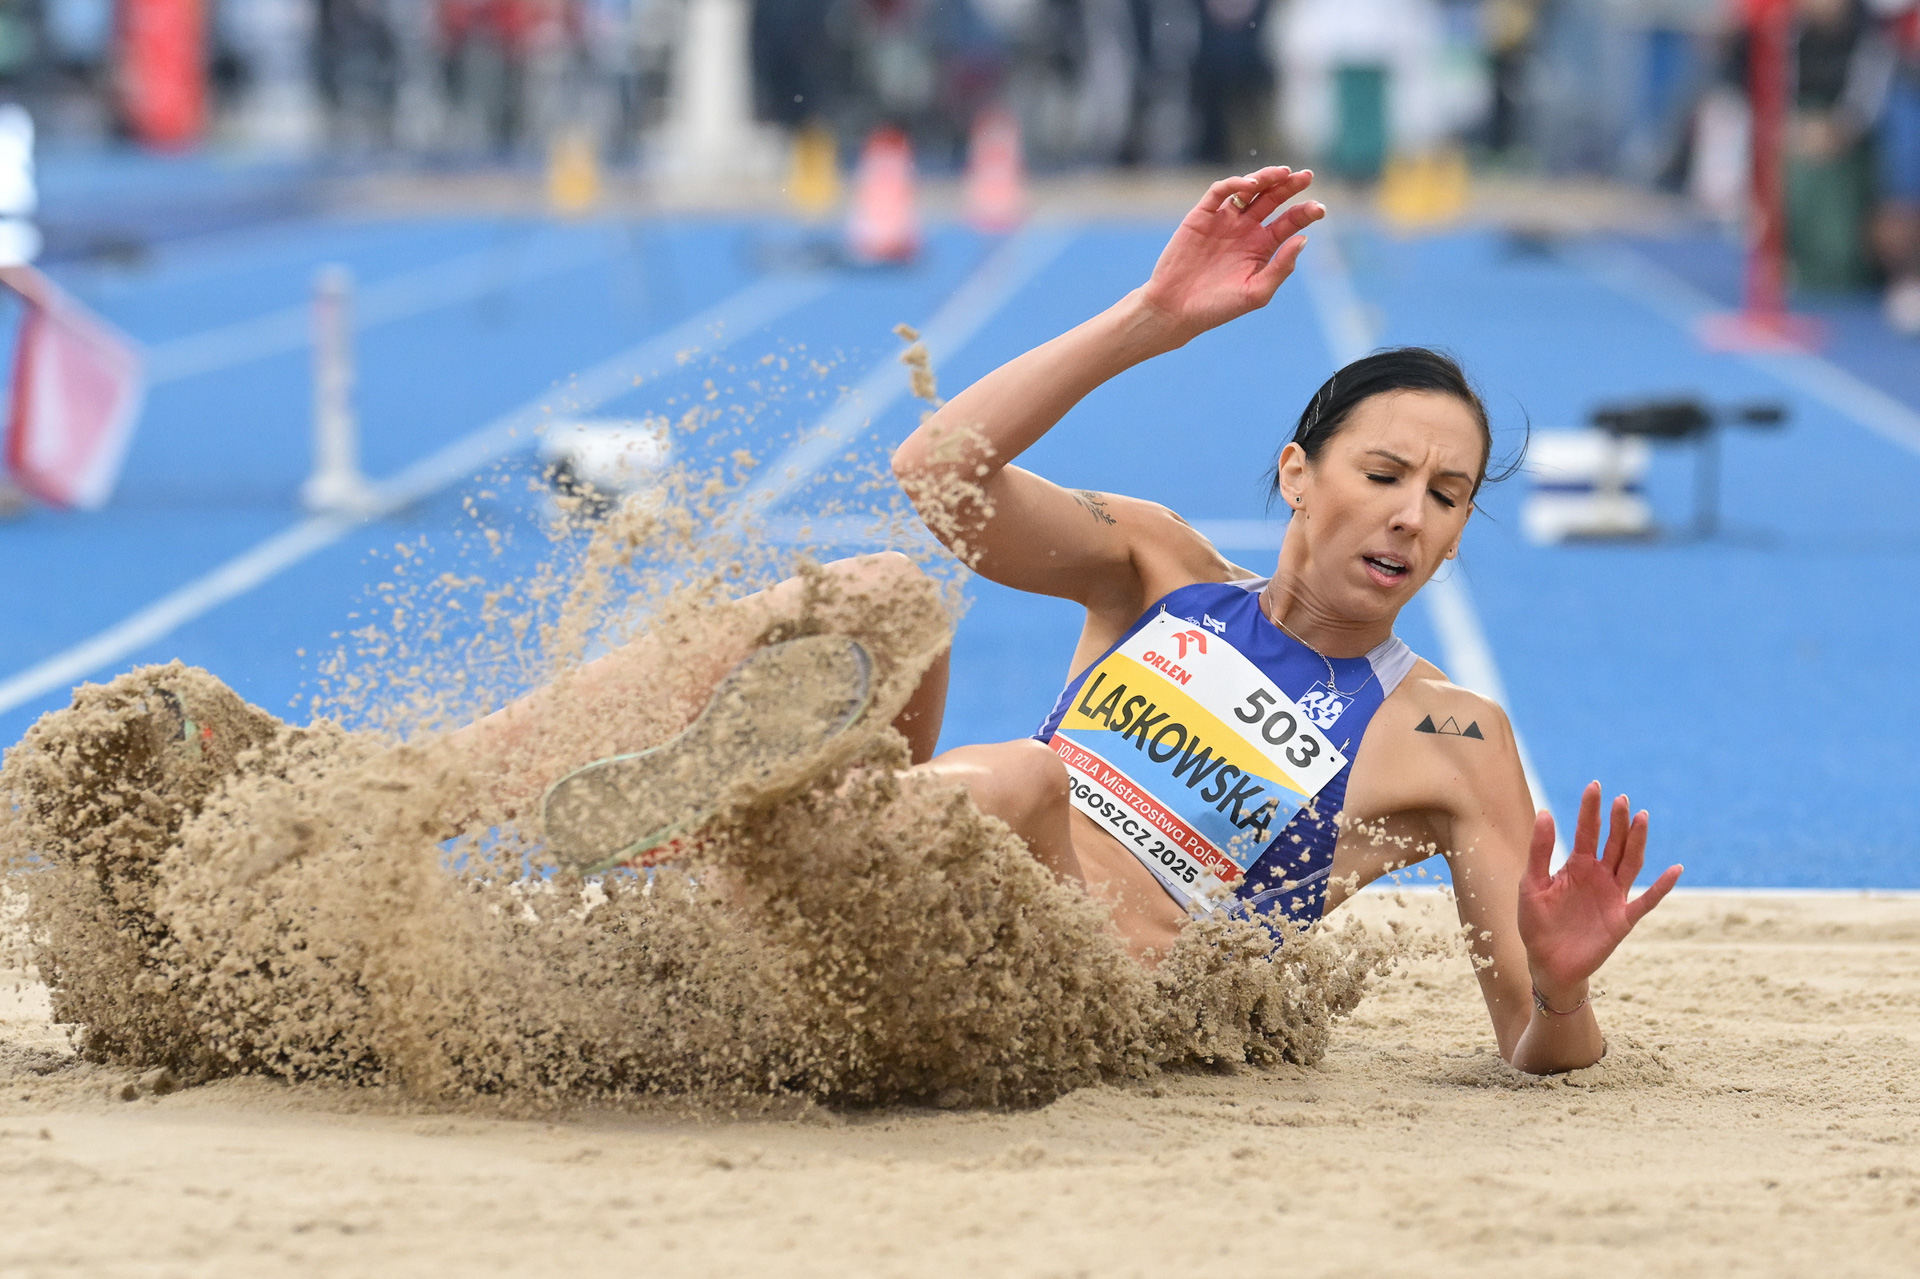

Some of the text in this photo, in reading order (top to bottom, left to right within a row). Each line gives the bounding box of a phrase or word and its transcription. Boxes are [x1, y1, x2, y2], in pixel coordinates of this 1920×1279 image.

[1142, 650, 1193, 686] ORLEN
[1077, 671, 1280, 844] LASKOWSKA
[1233, 687, 1321, 768] 503
[1056, 742, 1231, 877] 101. PZLA Mistrzostwa Polski
[1068, 774, 1199, 884] DGOSZCZ 2025
